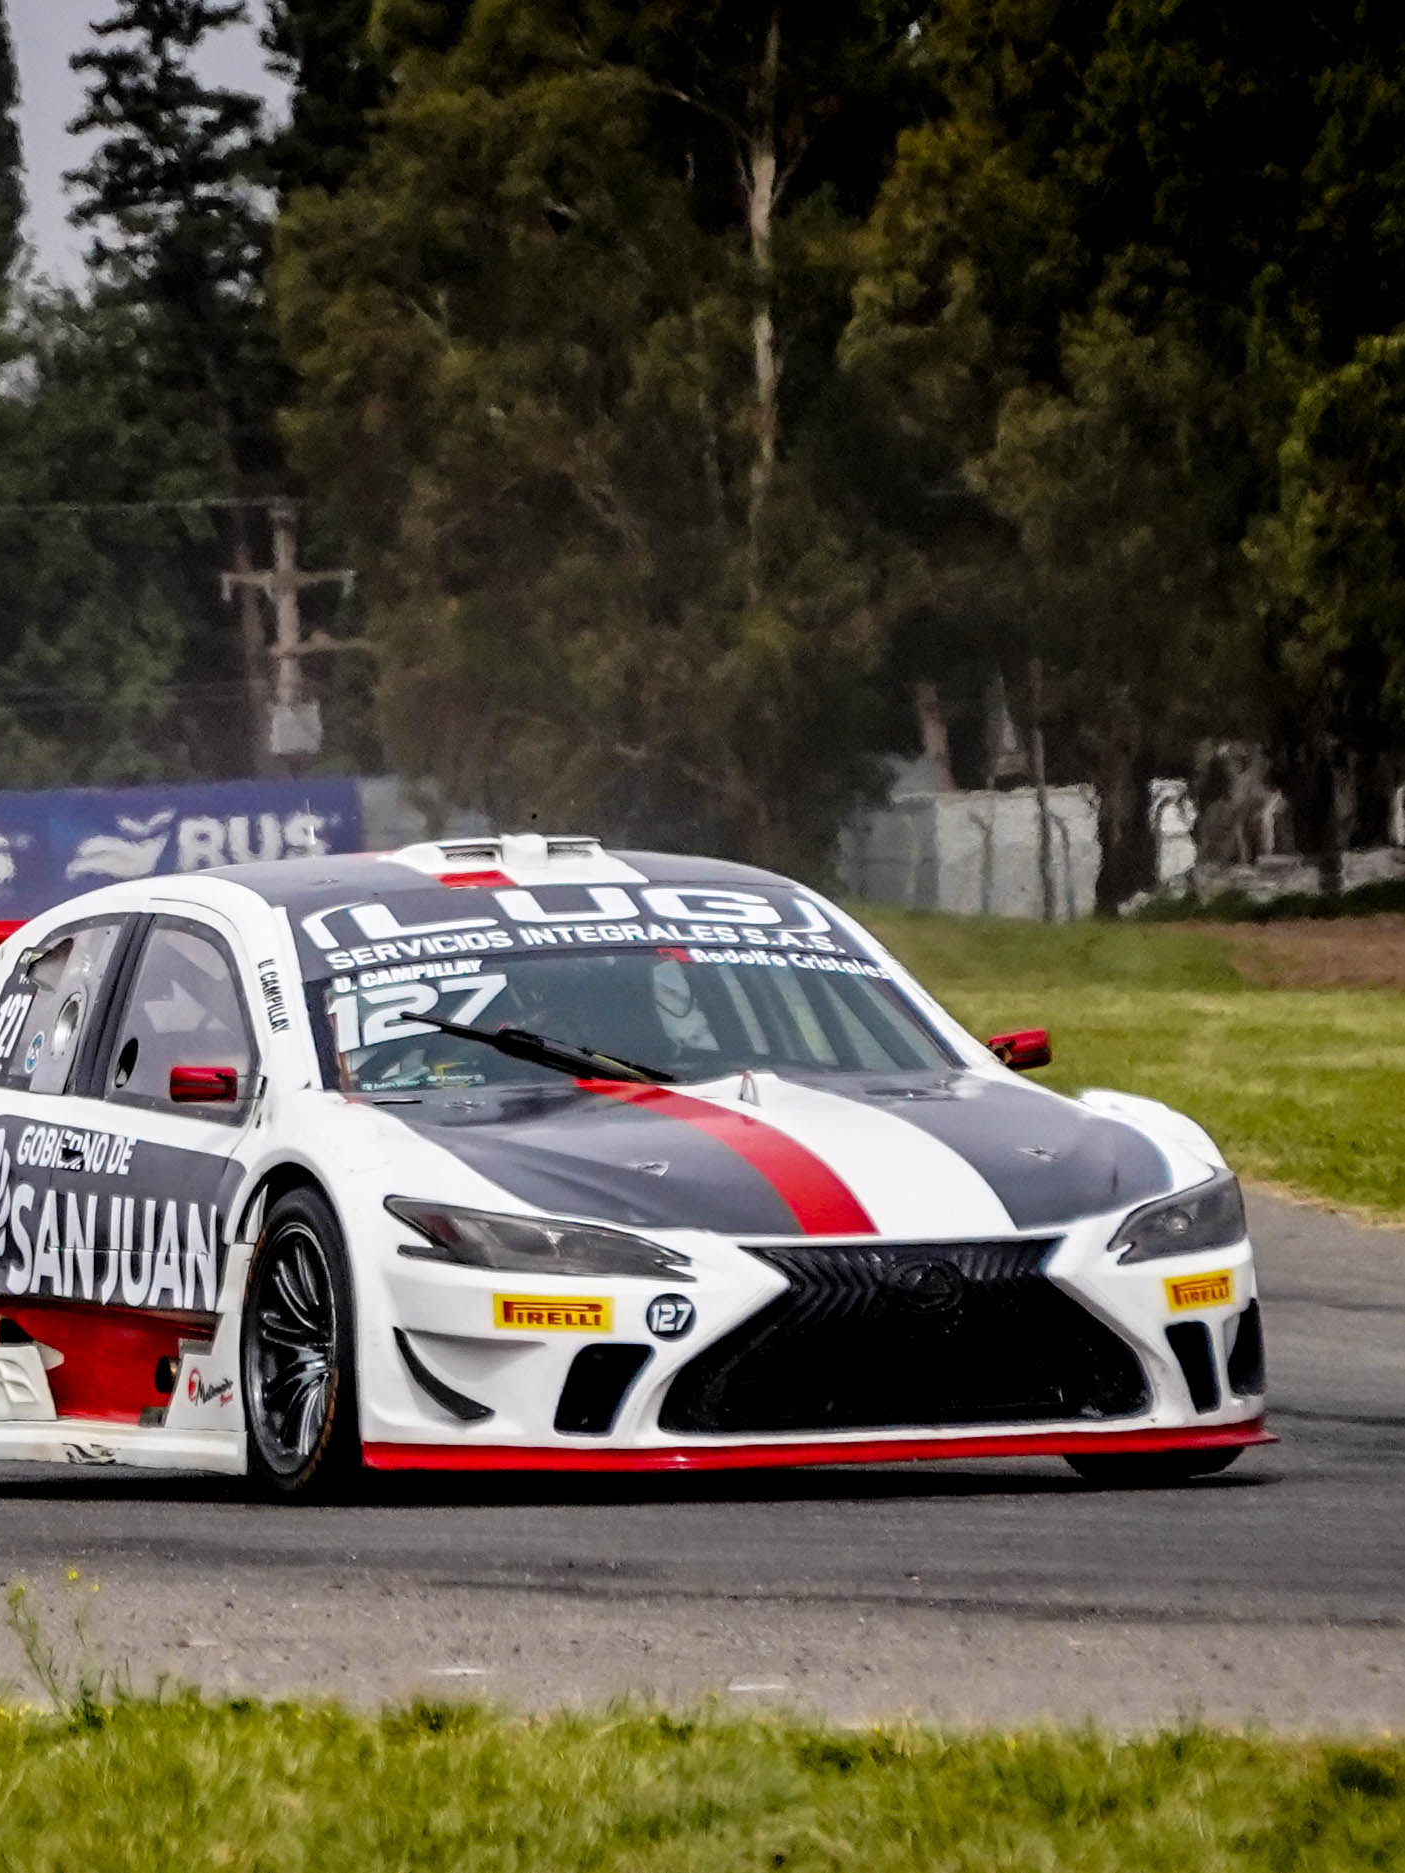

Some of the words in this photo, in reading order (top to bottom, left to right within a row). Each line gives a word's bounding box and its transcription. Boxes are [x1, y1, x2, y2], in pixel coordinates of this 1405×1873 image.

[176, 813, 330, 874] RUS
[325, 929, 514, 970] SERVICIOS
[517, 923, 740, 946] INTEGRALES
[740, 927, 847, 954] S.A.S.
[689, 948, 788, 968] Rodolfo
[788, 951, 893, 980] Cristales
[360, 958, 484, 989] CAMPILLAY
[260, 970, 291, 1035] CAMPILLAY
[327, 973, 508, 1054] 127
[17, 1124, 111, 1174] GOBIERNO
[105, 1135, 137, 1175] DE
[7, 1183, 98, 1300] SAN
[101, 1196, 218, 1312] JUAN
[502, 1300, 603, 1327] PIRELLI
[1171, 1277, 1230, 1306] PIRELLI
[651, 1302, 692, 1333] 127
